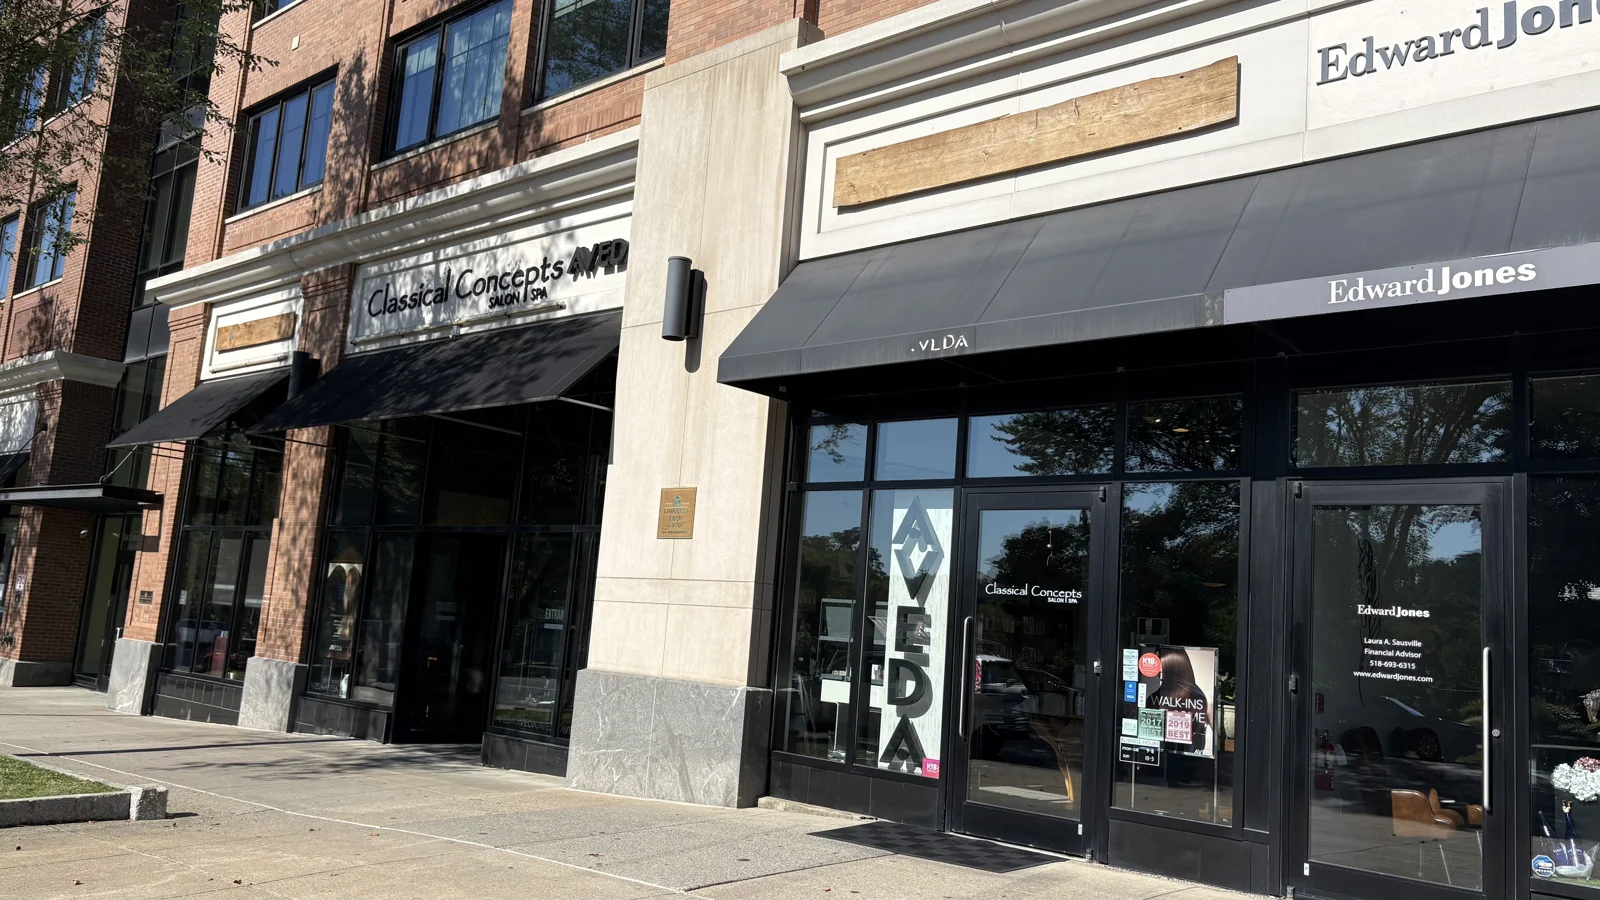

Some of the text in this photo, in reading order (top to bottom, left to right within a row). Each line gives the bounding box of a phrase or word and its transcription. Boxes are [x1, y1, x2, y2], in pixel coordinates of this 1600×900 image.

[1316, 0, 1600, 86] EdwardJon
[368, 238, 630, 317] Classical Concepts AVED
[1327, 262, 1537, 305] EdwardJones
[488, 285, 549, 310] SALON SPA
[985, 582, 1083, 604] Classical Concepts
[1357, 604, 1430, 618] EdwardJones
[879, 496, 943, 770] AVEDA
[1364, 637, 1422, 648] Laura A. Sausville
[1364, 648, 1422, 659] Financial Advisor
[1142, 657, 1155, 665] K18
[1369, 660, 1416, 670] 518-693-6315
[1353, 670, 1434, 683] www.edwardjones.com
[1151, 695, 1204, 710] WALK-INS
[1141, 717, 1162, 727] 2017
[1168, 720, 1190, 729] 2019
[1141, 727, 1162, 737] BEST
[1168, 730, 1190, 740] BEST
